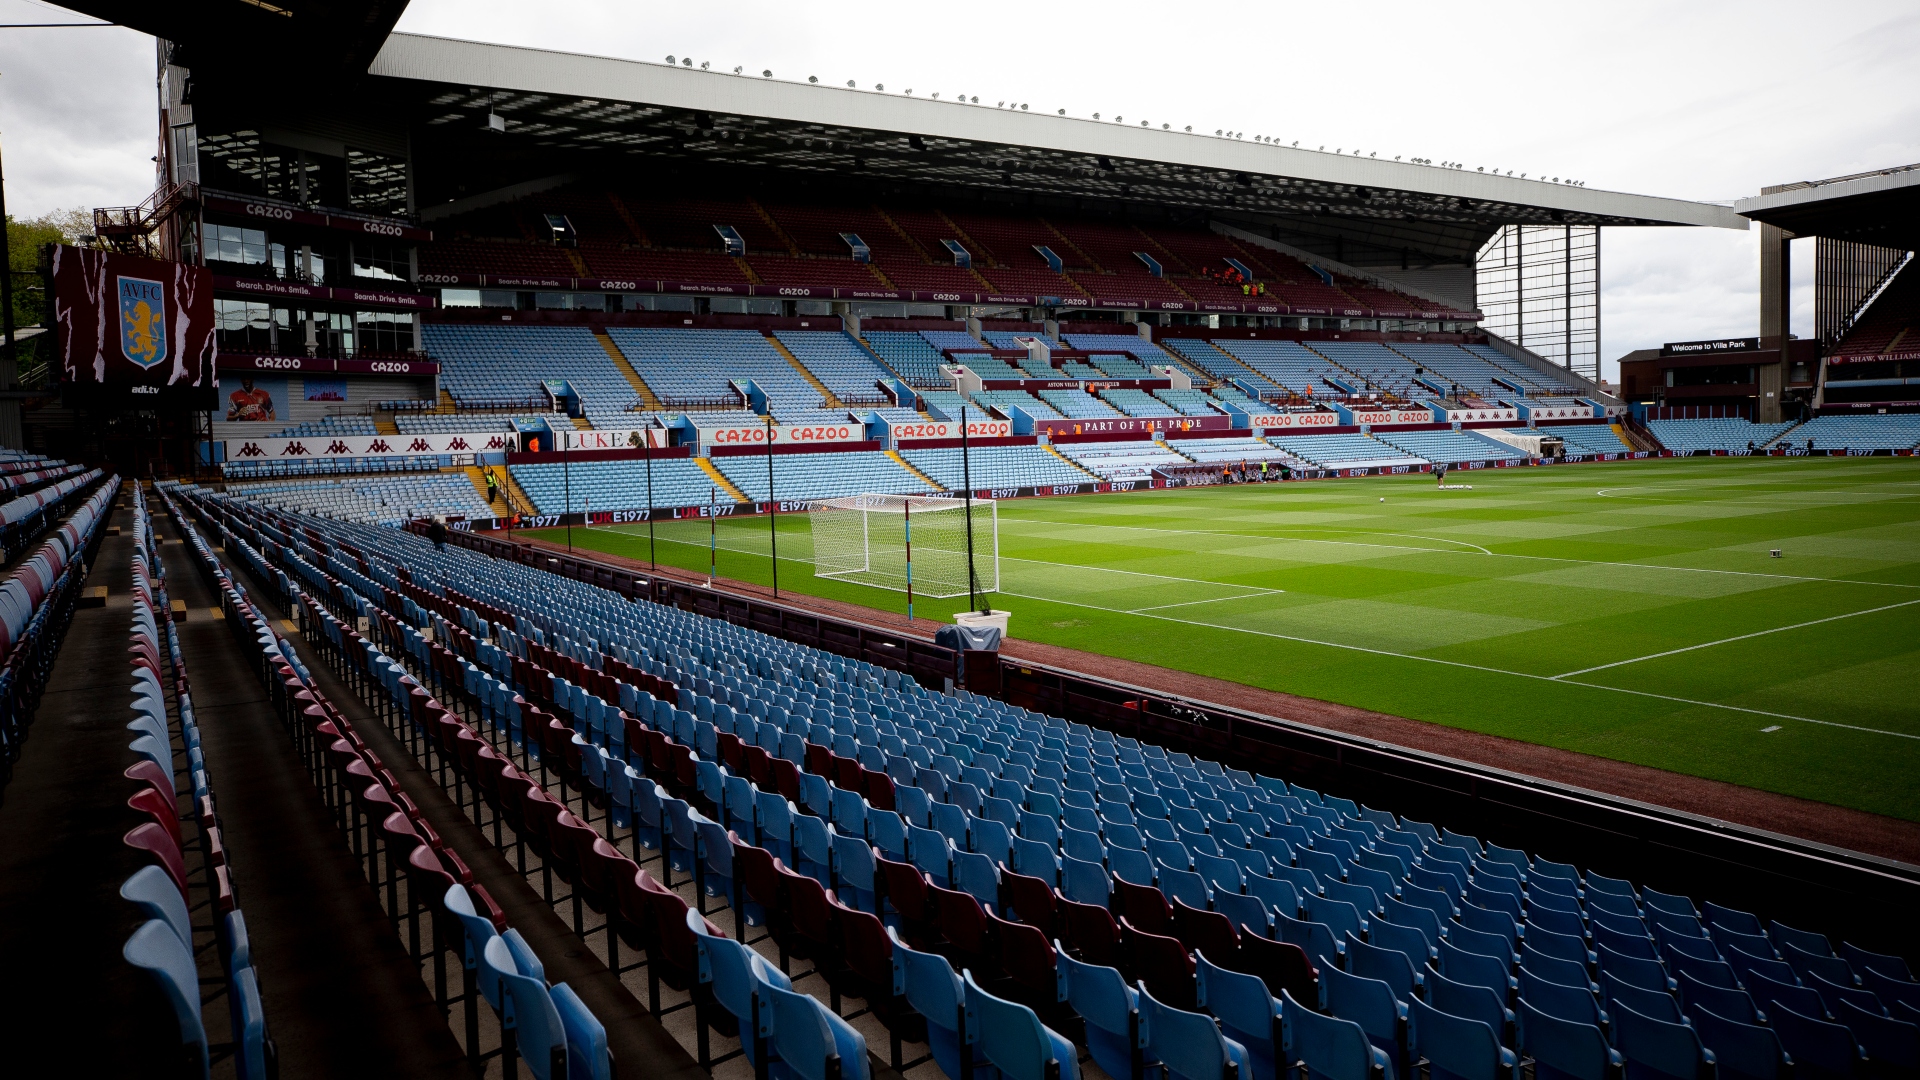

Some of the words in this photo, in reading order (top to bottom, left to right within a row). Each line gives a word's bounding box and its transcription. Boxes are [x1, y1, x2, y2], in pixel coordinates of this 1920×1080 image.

[246, 204, 293, 220] CAZOO
[363, 222, 403, 237] CAZOO
[417, 274, 459, 284] CAZOO
[498, 278, 522, 286] Search.
[122, 282, 160, 301] AVFC
[235, 280, 264, 291] Search.
[265, 283, 287, 293] Drive.
[288, 286, 311, 295] Smile.
[600, 281, 636, 290] CAZOO
[680, 284, 701, 292] Search.
[779, 287, 811, 296] CAZOO
[354, 292, 378, 302] Search.
[378, 294, 397, 303] Drive.
[398, 296, 417, 305] Smile.
[933, 293, 960, 301] CAZOO
[1063, 298, 1088, 306] CAZOO
[1672, 344, 1703, 352] Welcome
[1877, 352, 1920, 361] WILLIAMS
[254, 357, 301, 369] CAZOO
[370, 361, 410, 373] CAZOO
[131, 385, 160, 394] adi.tv
[1254, 415, 1292, 427] CAZOO
[1298, 414, 1334, 425] CAZOO
[1358, 413, 1392, 424] CAZOO
[1397, 412, 1429, 422] CAZOO
[893, 424, 947, 438] CAZOO
[1084, 421, 1114, 431] PART
[1120, 421, 1135, 430] OF
[1168, 419, 1202, 429] PRDE
[565, 432, 624, 449] LUKE
[715, 428, 778, 443] CAZOO
[790, 426, 850, 441] CAZOO
[1658, 449, 1695, 458] LUKE1977
[1827, 449, 1875, 457] LUKE1977
[1378, 465, 1410, 475] LUKE1977
[1457, 461, 1486, 470] LUKE1977
[1336, 468, 1369, 477] LUKE1977
[1034, 484, 1079, 496] LUKE1977
[1093, 481, 1136, 493] LUKE1977
[971, 488, 1019, 500] LUKE1977
[673, 504, 735, 519] LUKE1977
[755, 500, 812, 514] LUKE1977
[585, 510, 650, 525] LUKE1977
